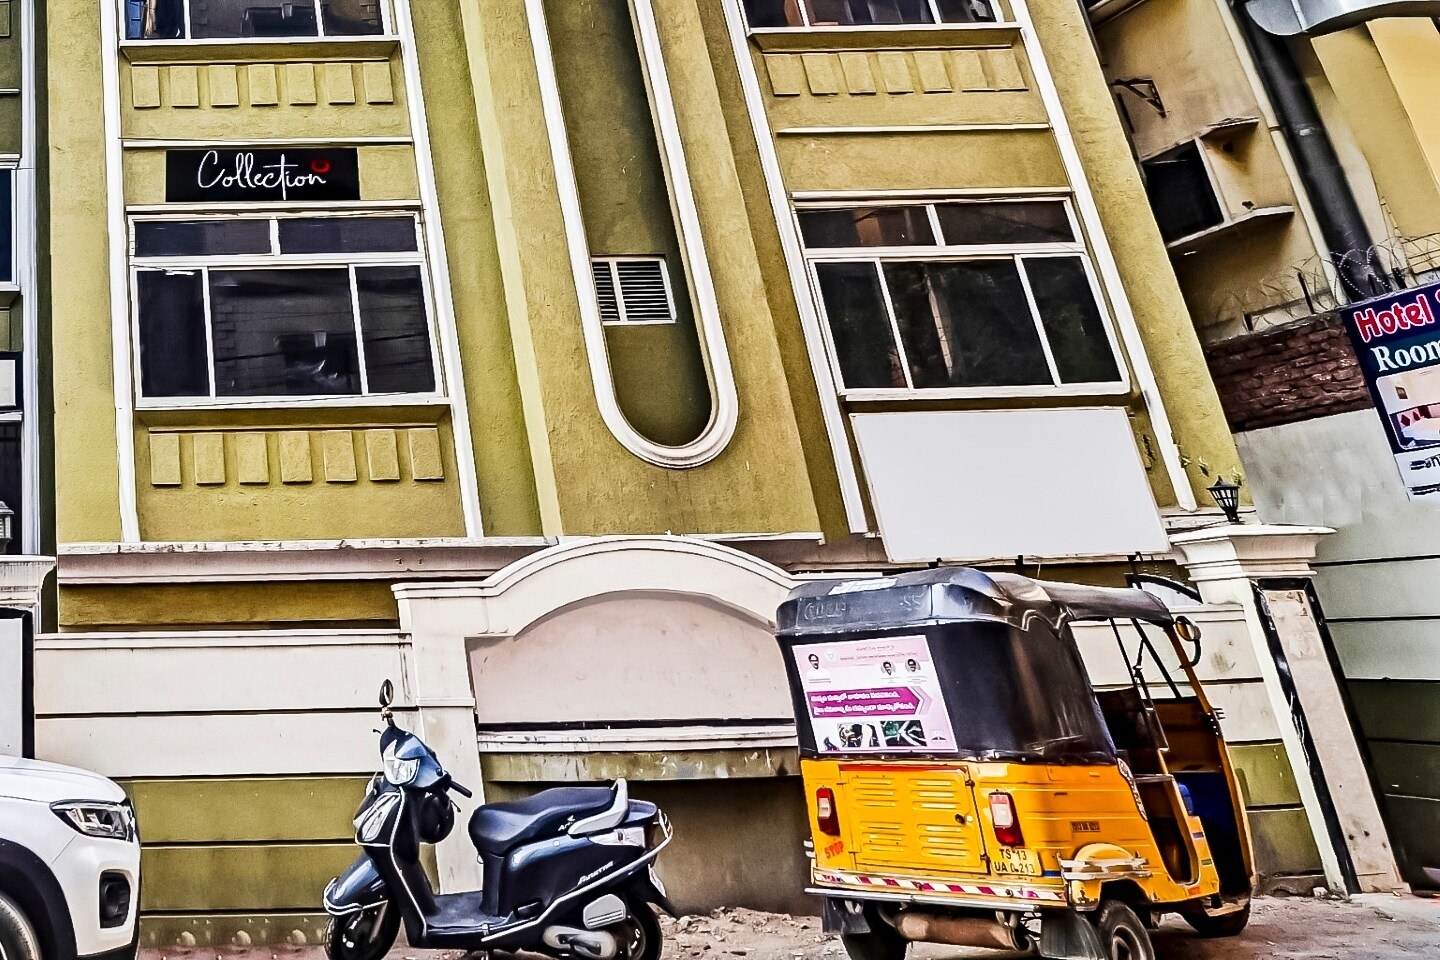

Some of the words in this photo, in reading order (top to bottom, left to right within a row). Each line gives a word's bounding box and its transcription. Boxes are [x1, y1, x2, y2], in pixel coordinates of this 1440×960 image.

[197, 150, 326, 200] Collection
[1353, 294, 1435, 343] Hotel
[824, 841, 844, 859] STOP
[999, 848, 1011, 859] TS
[994, 861, 1008, 872] UA
